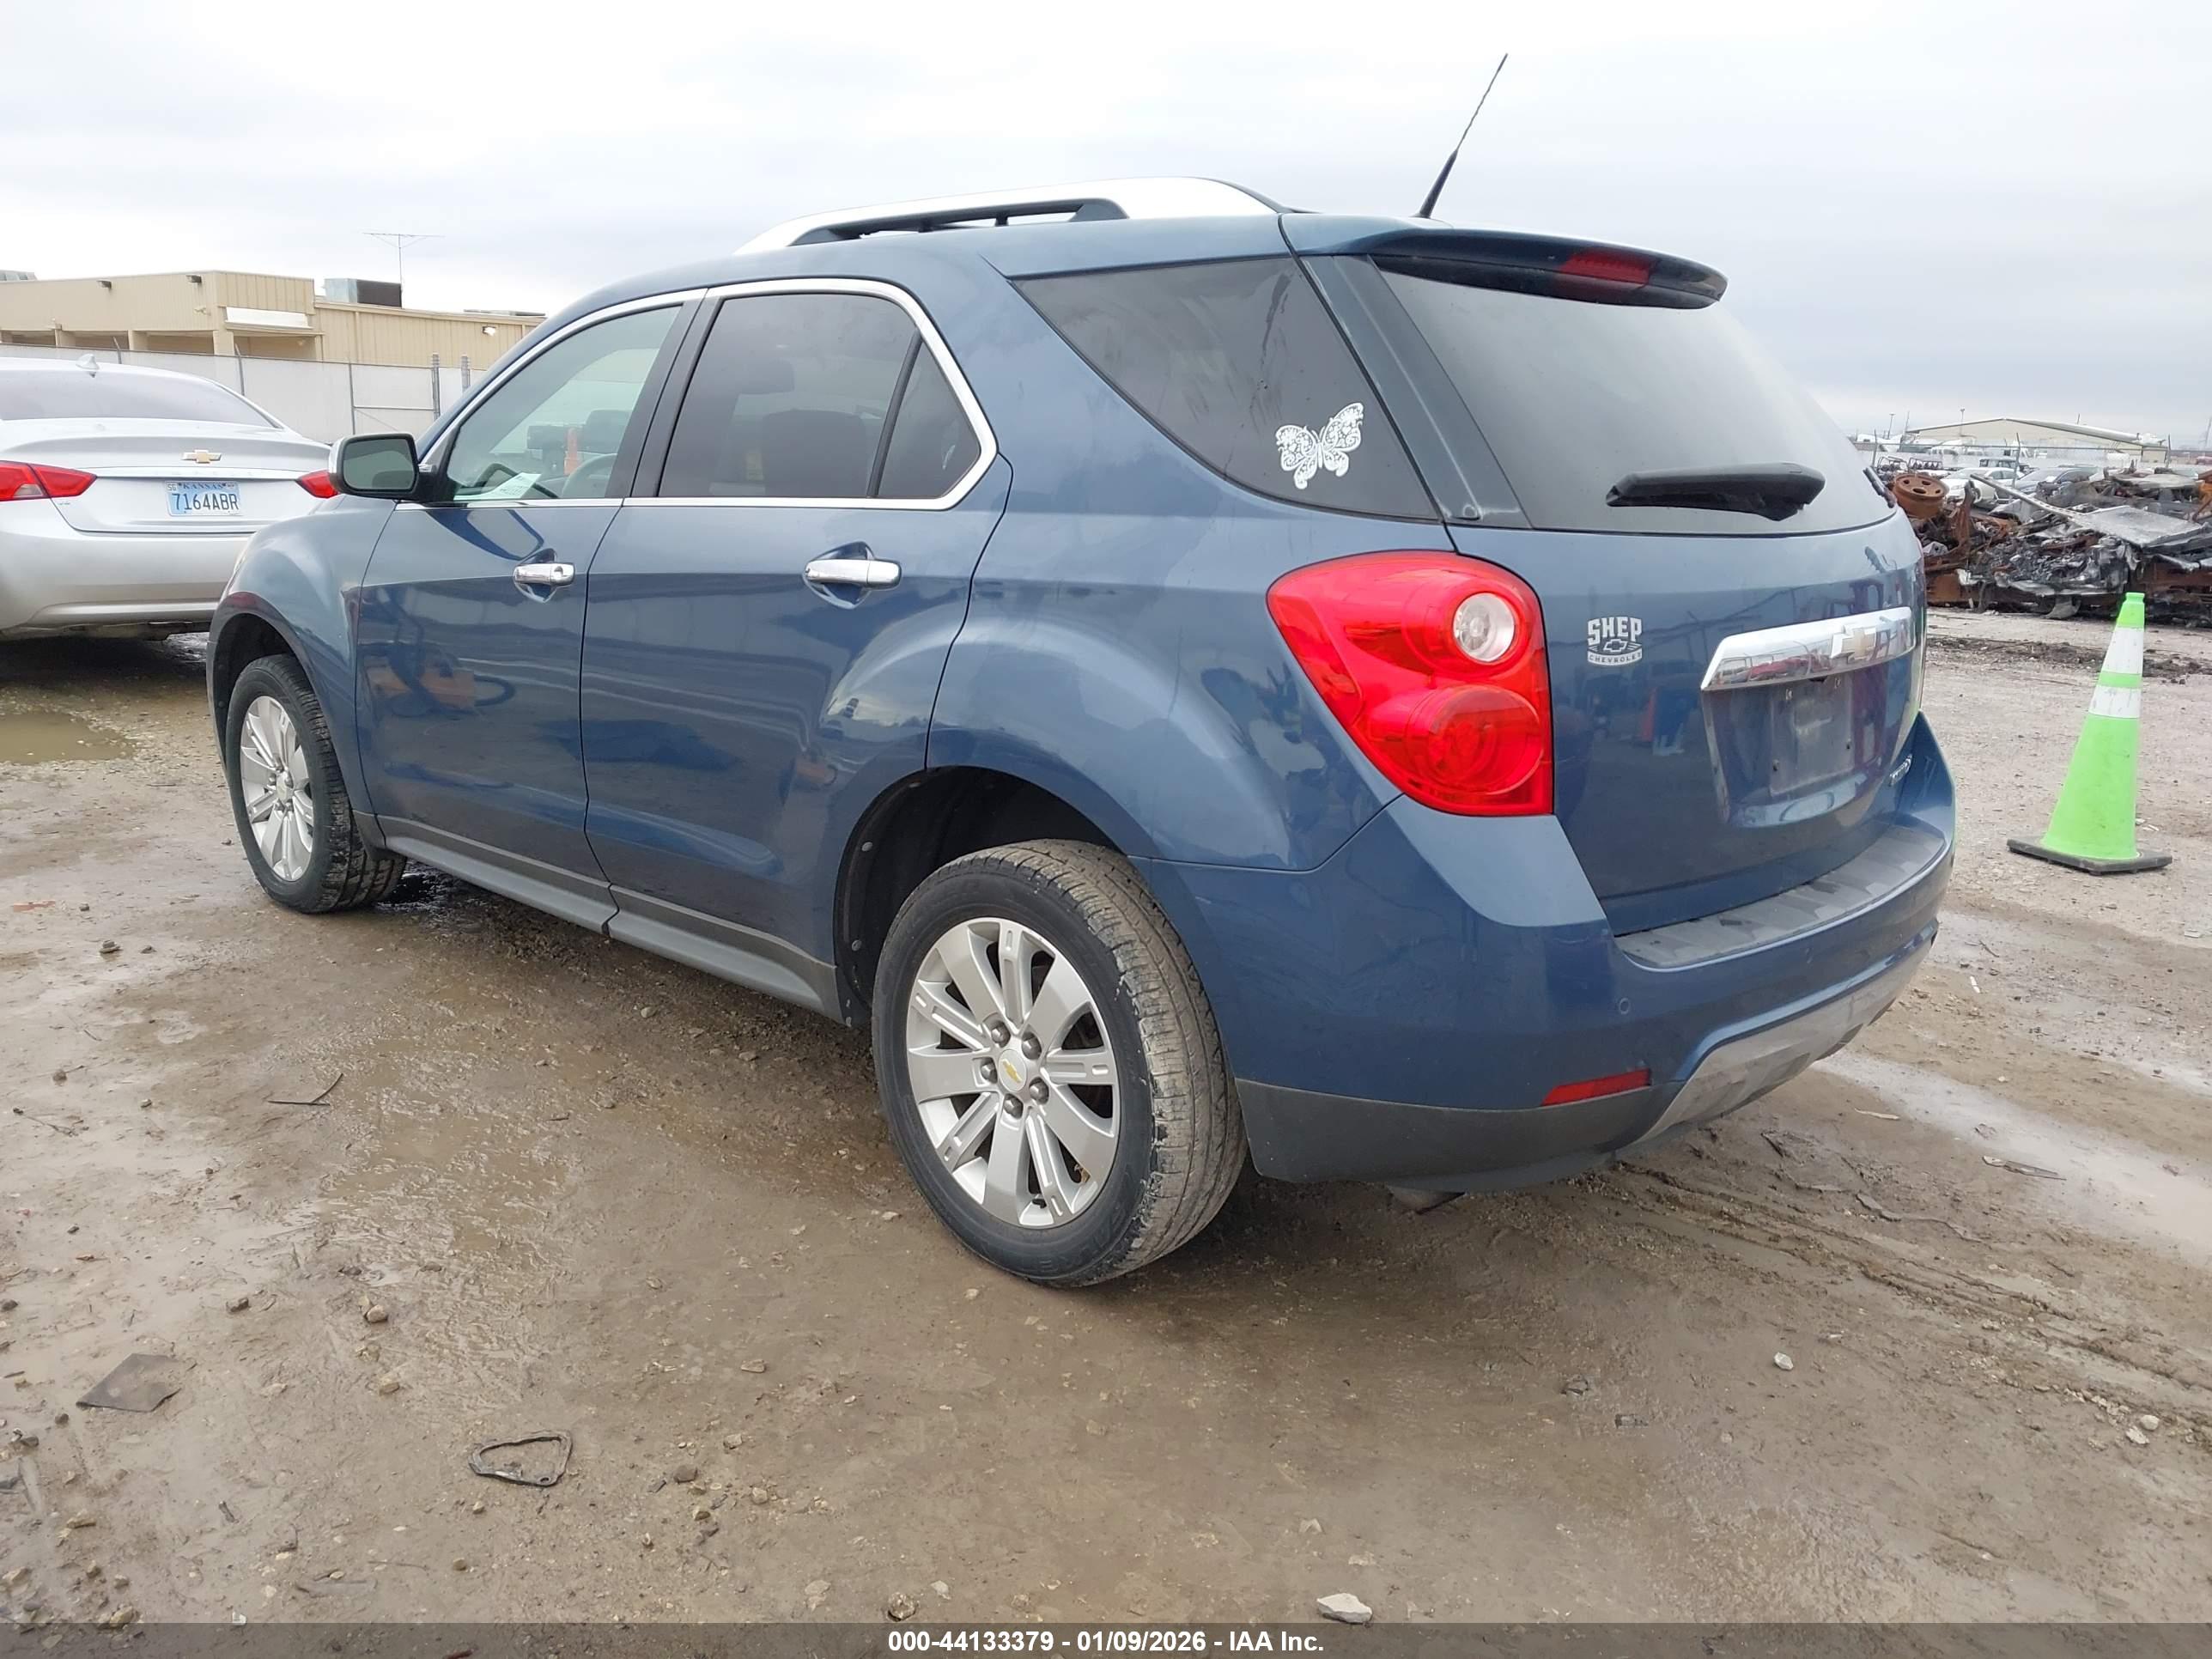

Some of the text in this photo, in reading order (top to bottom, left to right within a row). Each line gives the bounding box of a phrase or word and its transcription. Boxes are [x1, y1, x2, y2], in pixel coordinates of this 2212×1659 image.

[172, 493, 239, 510] 7164ABR
[1587, 616, 1643, 646] SHEP
[1588, 651, 1642, 664] CHEVROLET
